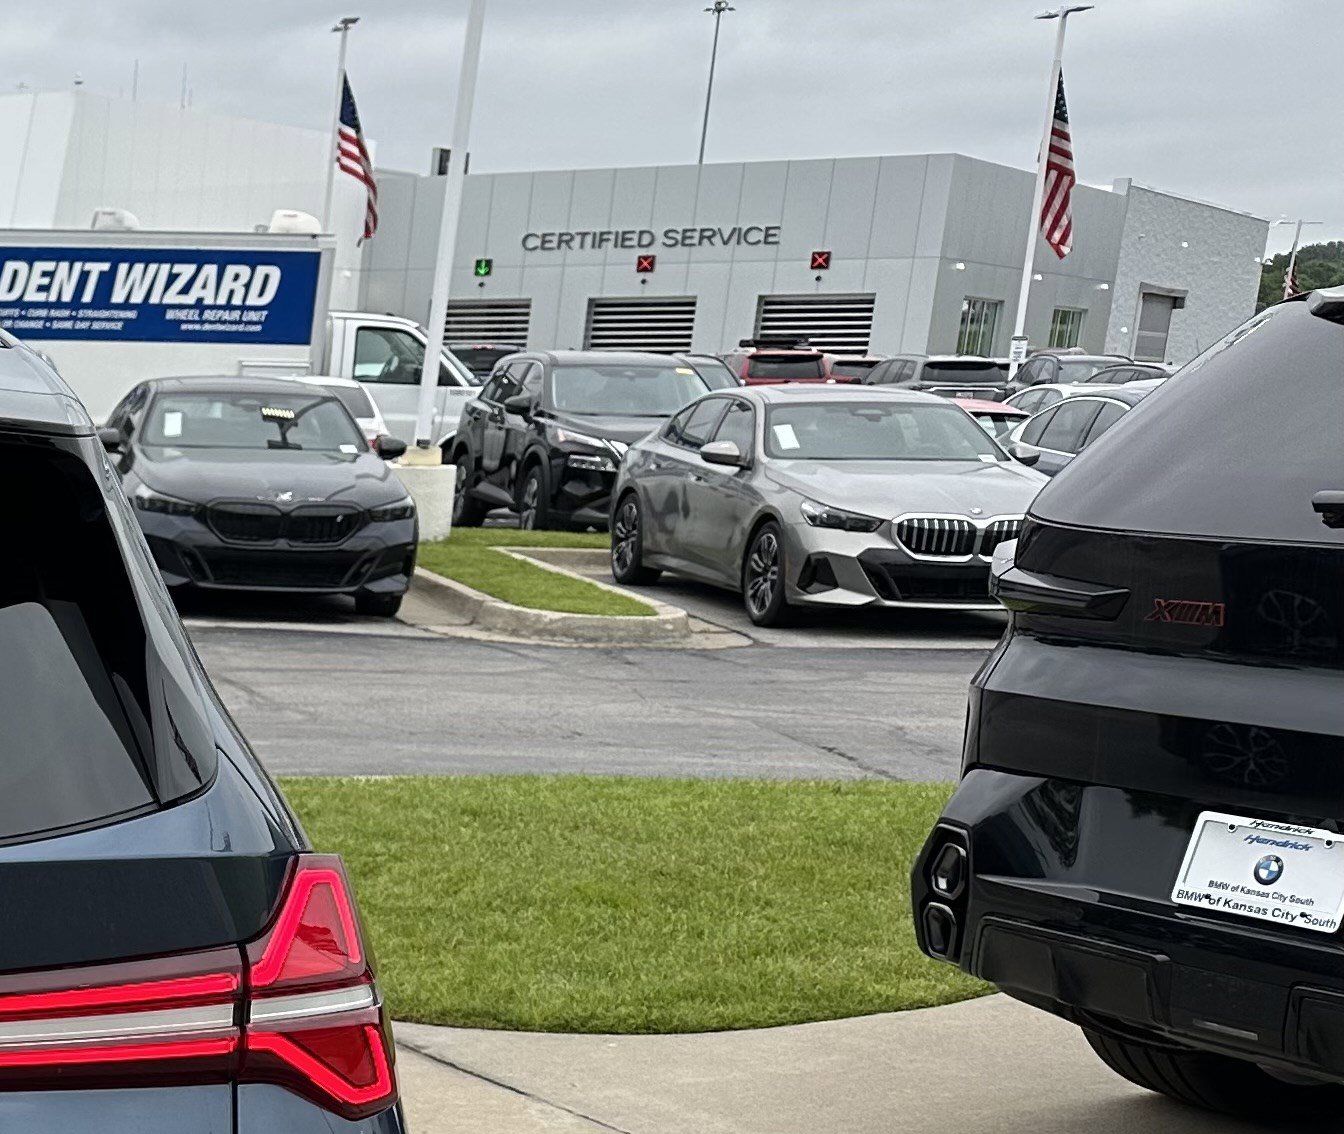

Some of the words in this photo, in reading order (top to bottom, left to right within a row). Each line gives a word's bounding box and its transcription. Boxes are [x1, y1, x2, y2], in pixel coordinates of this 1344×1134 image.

[521, 229, 656, 251] CERTIFIED
[661, 226, 781, 248] SERVICE
[110, 261, 282, 307] WIZARD
[165, 309, 200, 321] WHEEL
[202, 309, 242, 322] REPAIR
[242, 310, 269, 323] UNIT
[1249, 820, 1315, 835] Hendrick
[1244, 834, 1313, 851] Hendrick
[1208, 880, 1230, 891] BMW
[1230, 882, 1240, 893] of
[1240, 885, 1270, 899] Kansas
[1271, 891, 1288, 903] City
[1288, 894, 1315, 906] South
[1176, 889, 1205, 903] BMW
[1209, 895, 1222, 906] of
[1222, 898, 1269, 916] Kansas
[1271, 907, 1298, 922] City
[1304, 913, 1337, 929] South
